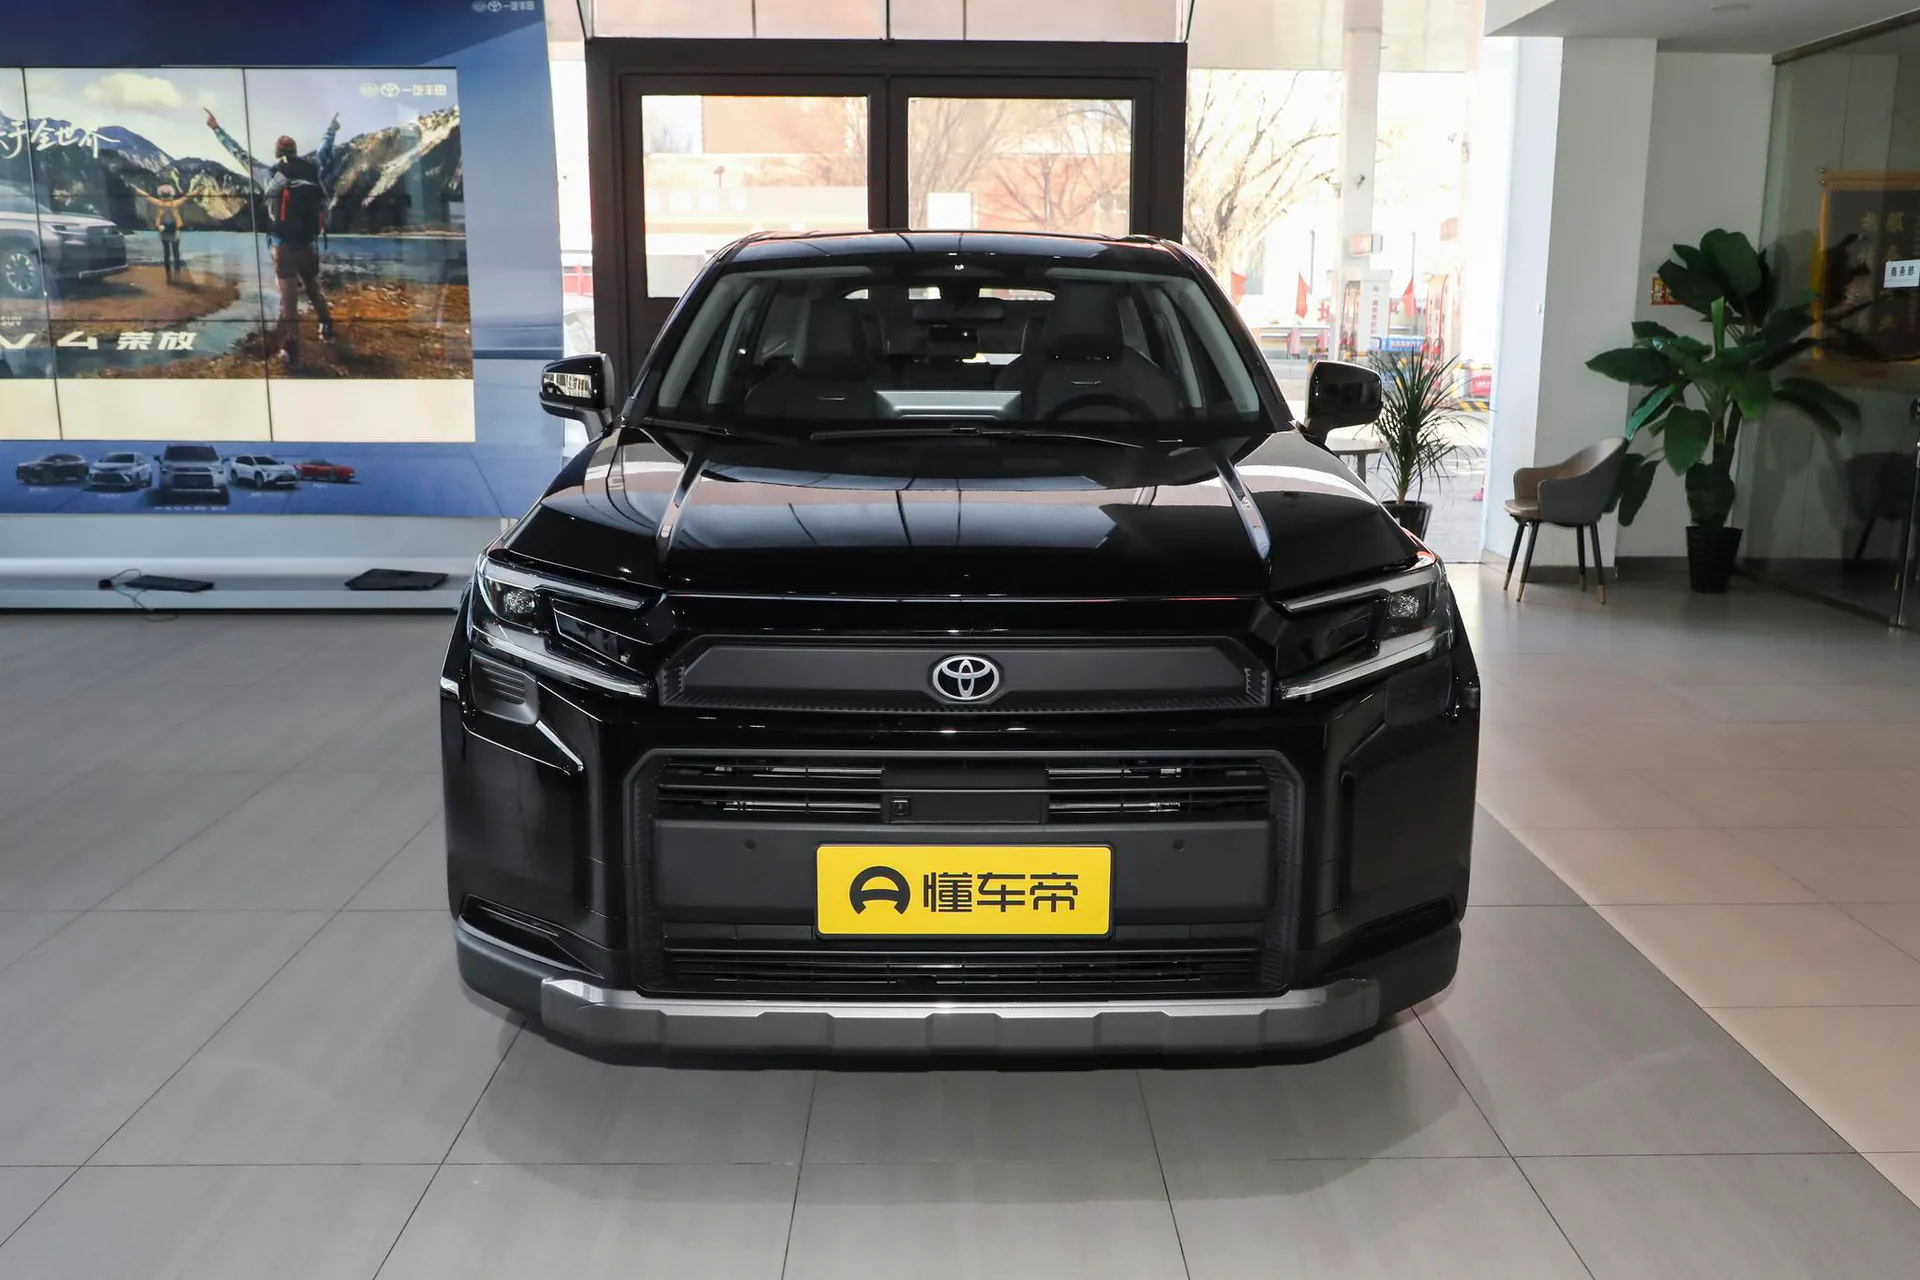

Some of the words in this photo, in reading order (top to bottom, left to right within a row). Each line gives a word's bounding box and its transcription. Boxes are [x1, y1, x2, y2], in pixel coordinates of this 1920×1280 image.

[116, 331, 197, 351] 荣放
[923, 871, 1079, 913] 懂车帝
